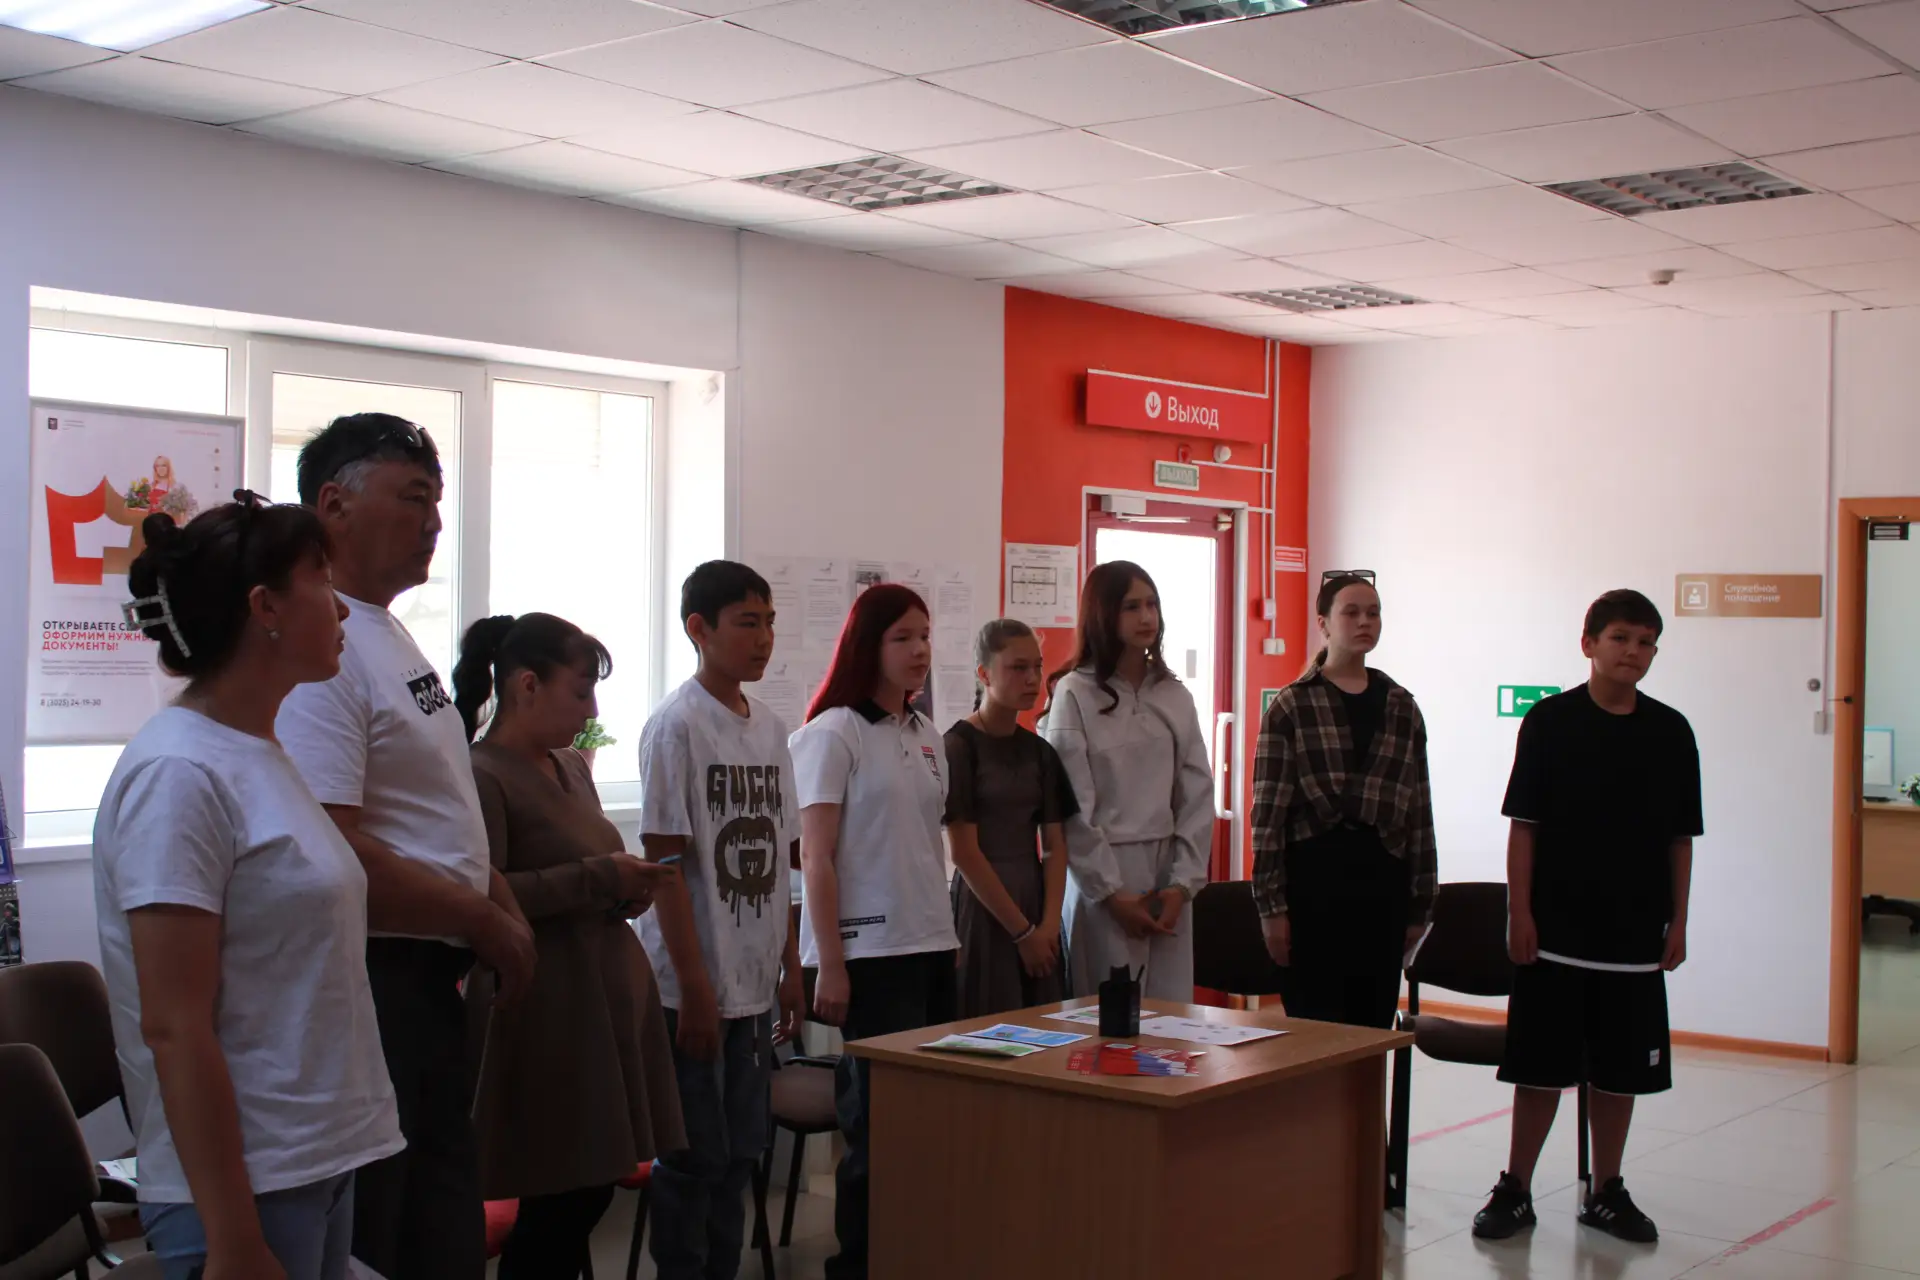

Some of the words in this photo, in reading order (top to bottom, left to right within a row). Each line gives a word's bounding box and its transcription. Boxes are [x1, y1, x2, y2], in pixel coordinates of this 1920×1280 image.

[1167, 396, 1219, 431] Выход
[1160, 466, 1193, 485] ВЫХОД
[1724, 582, 1777, 593] Служебное
[1724, 593, 1780, 604] помещение
[42, 620, 116, 631] ОТКРЫВАЕТЕ
[42, 631, 105, 641] ОФОРМИМ
[108, 633, 152, 642] НУЖН
[42, 640, 120, 651] ДОКУМЕНТЫ!
